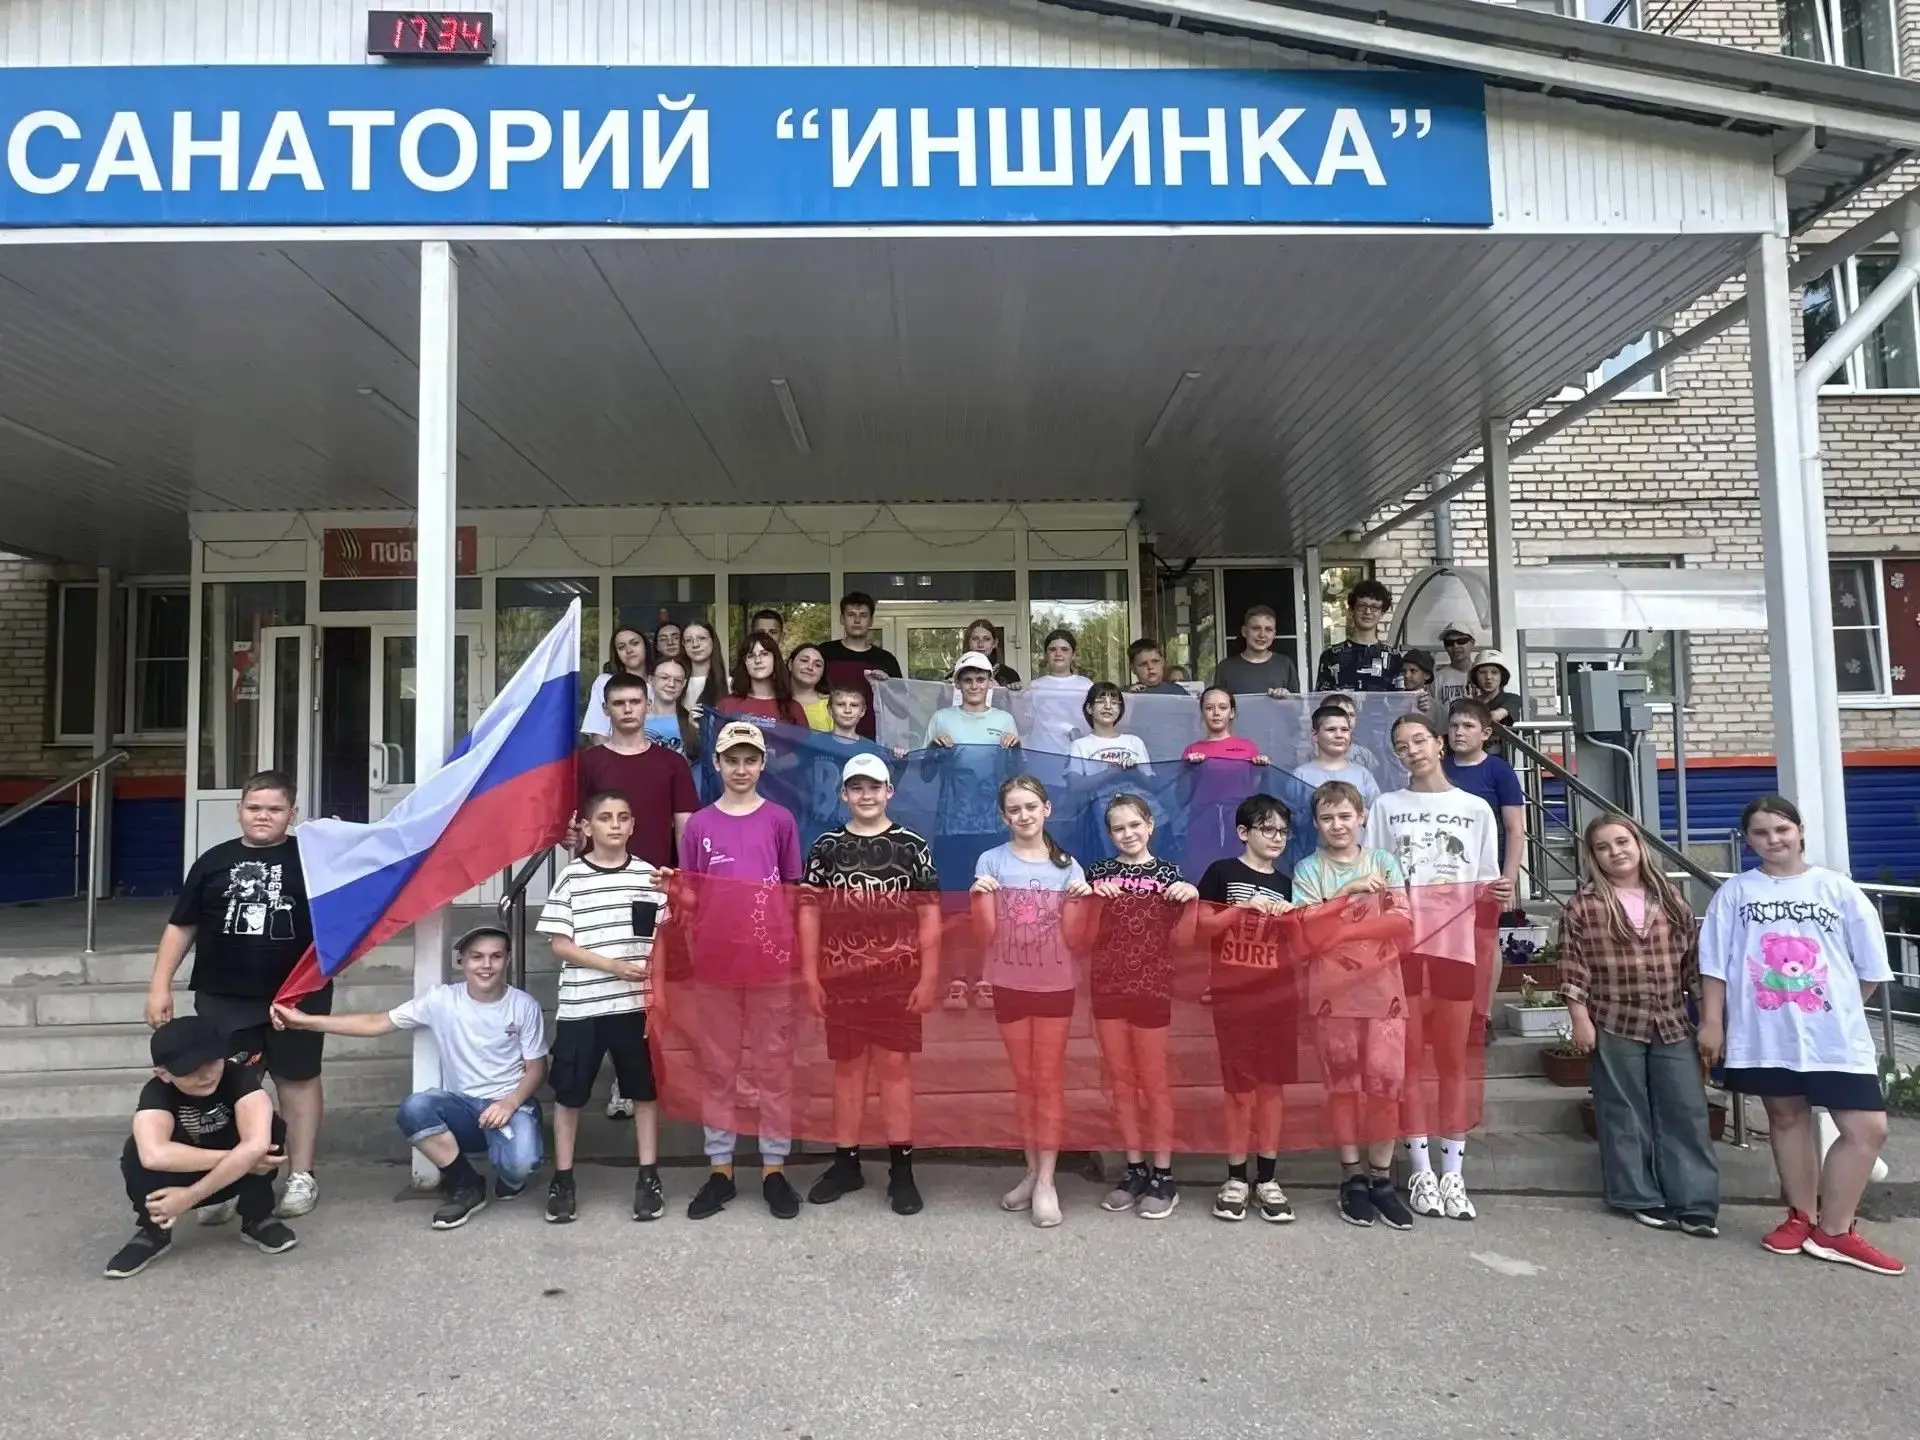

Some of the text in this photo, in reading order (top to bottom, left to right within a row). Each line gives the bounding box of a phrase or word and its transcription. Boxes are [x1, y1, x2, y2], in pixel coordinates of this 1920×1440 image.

[6, 93, 711, 195] САНАТОРИЙ
[1389, 812, 1475, 829] MILK CAT
[1221, 940, 1277, 966] SURF
